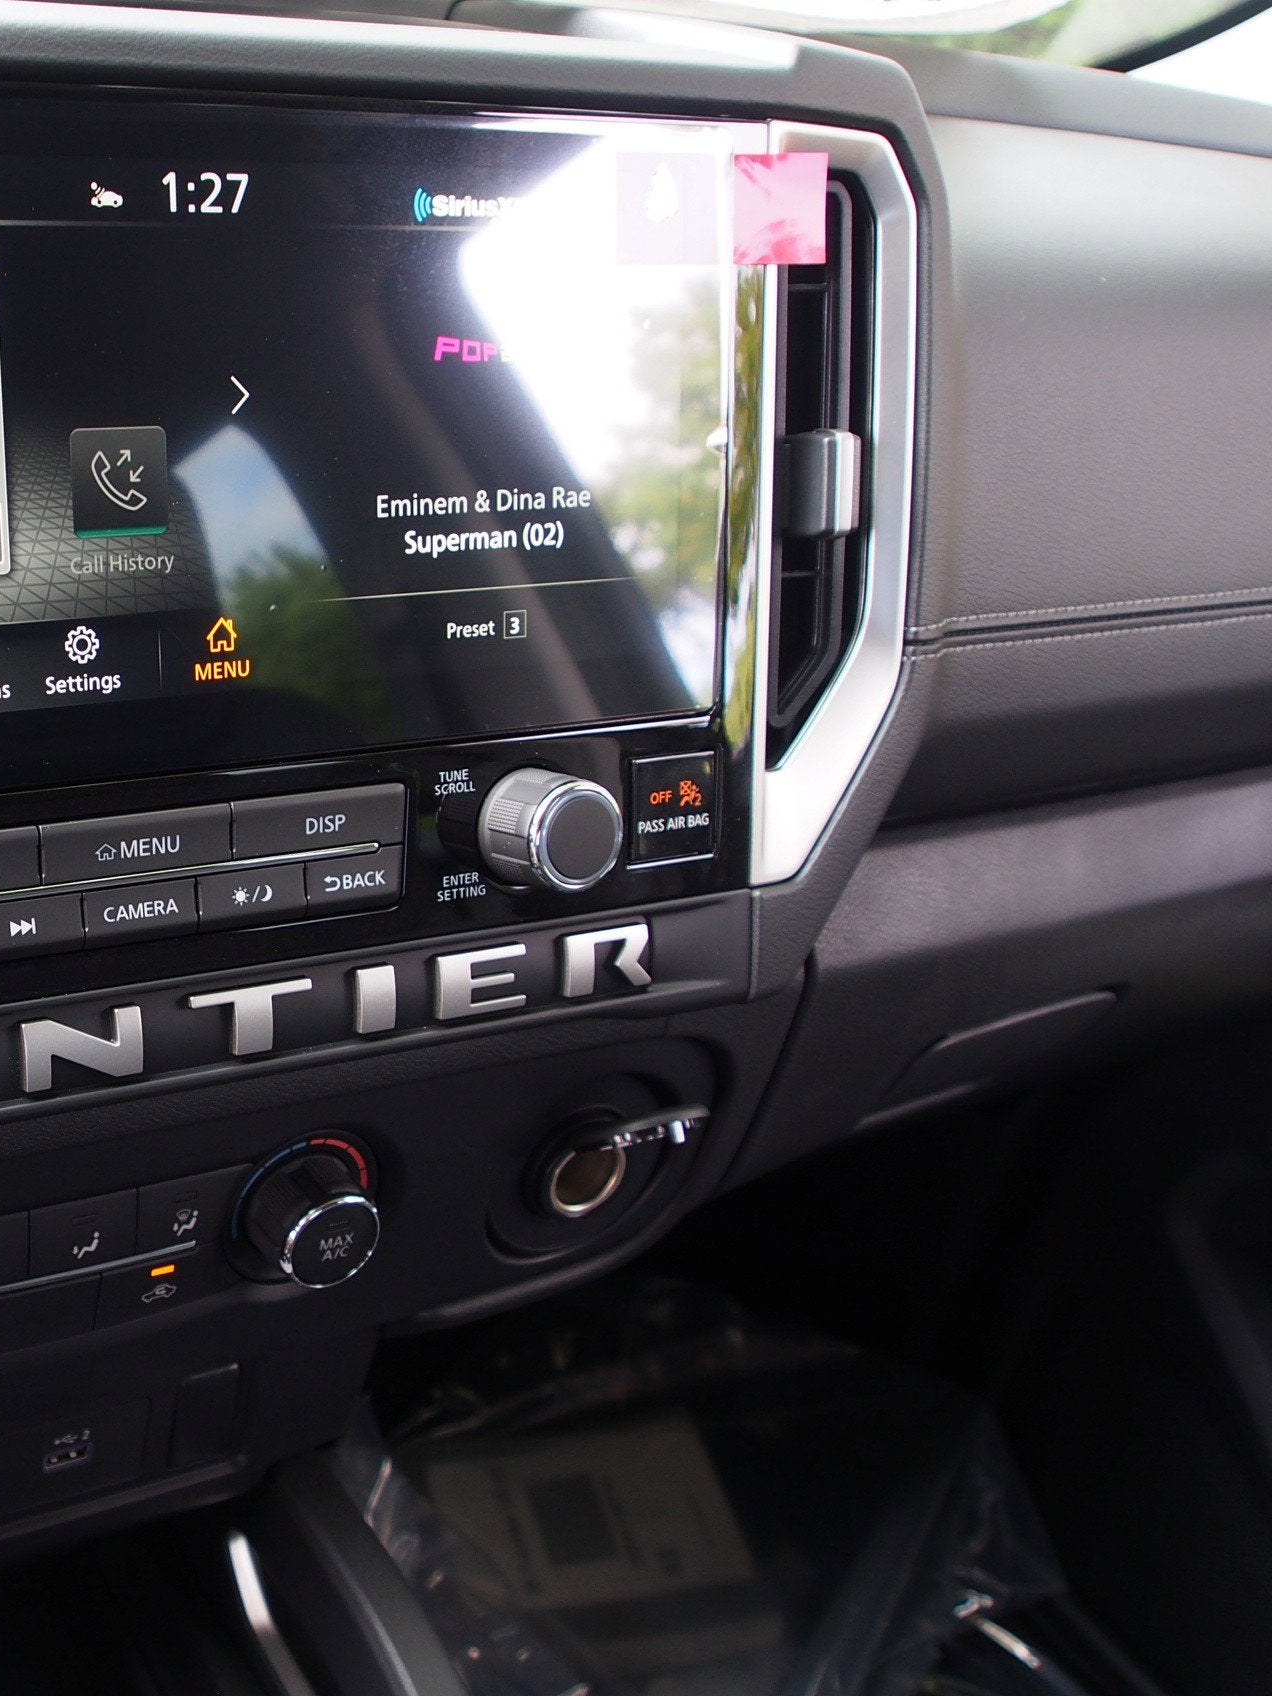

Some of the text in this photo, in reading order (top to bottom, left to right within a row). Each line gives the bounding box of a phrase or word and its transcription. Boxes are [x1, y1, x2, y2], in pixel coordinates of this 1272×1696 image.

[161, 171, 250, 214] 1:27
[376, 486, 592, 519] Eminem & Dina Rae
[404, 521, 565, 559] Superman (02)
[69, 552, 175, 575] Call History
[445, 615, 521, 640] Preset 3
[194, 659, 251, 682] MENU
[44, 672, 122, 696] Settings
[438, 768, 470, 783] TUNE
[433, 781, 476, 796] SCROLL
[649, 790, 673, 805] OFF
[304, 813, 347, 836] DISP
[638, 813, 710, 834] PASS AIR BAG
[119, 834, 181, 860] MENU
[342, 869, 387, 890] BACK
[442, 872, 479, 888] ENTER
[436, 885, 487, 902] SETTING
[102, 898, 180, 924] CAMERA
[318, 1232, 355, 1251] MAX
[320, 1246, 350, 1263] A/C
